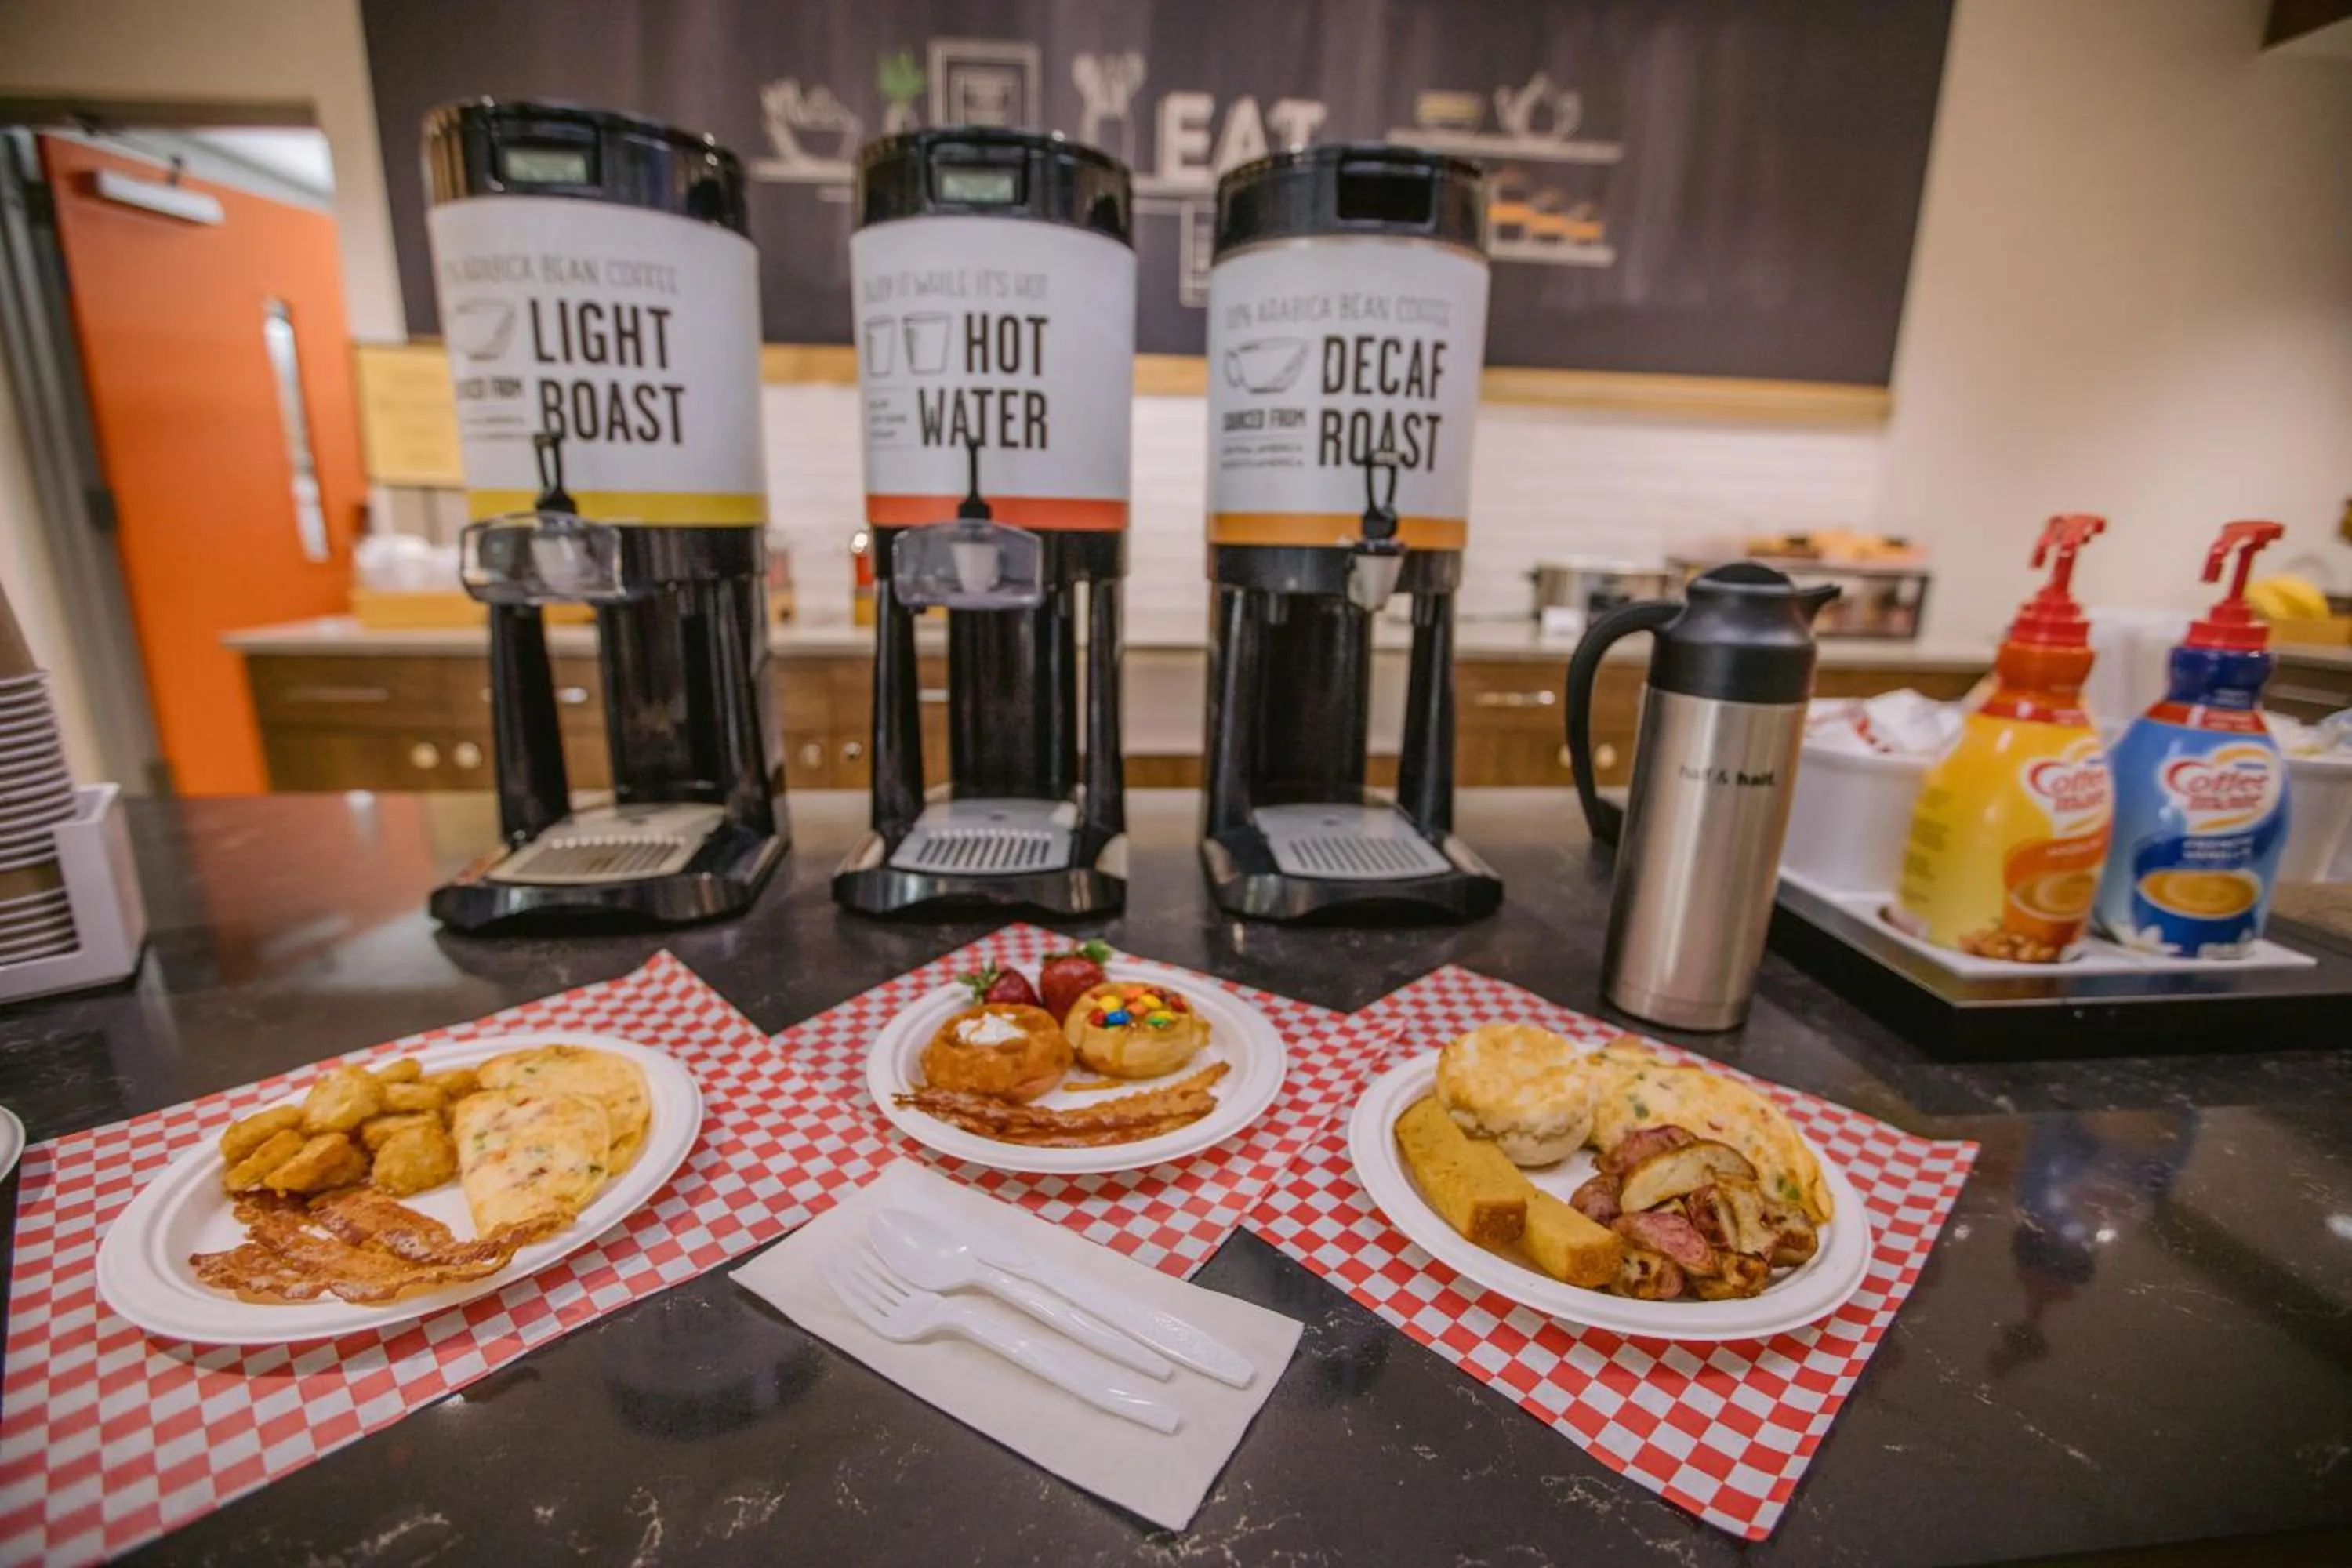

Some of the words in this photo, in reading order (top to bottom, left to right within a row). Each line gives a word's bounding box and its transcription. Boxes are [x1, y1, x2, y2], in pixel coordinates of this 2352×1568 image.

[1156, 89, 1327, 187] EAT
[530, 298, 673, 370] LIGHT
[964, 312, 1049, 376] HOT
[1321, 335, 1448, 401] DECAF
[538, 379, 686, 445] ROAST
[917, 387, 1049, 451] WATER
[1318, 408, 1443, 473] ROAST
